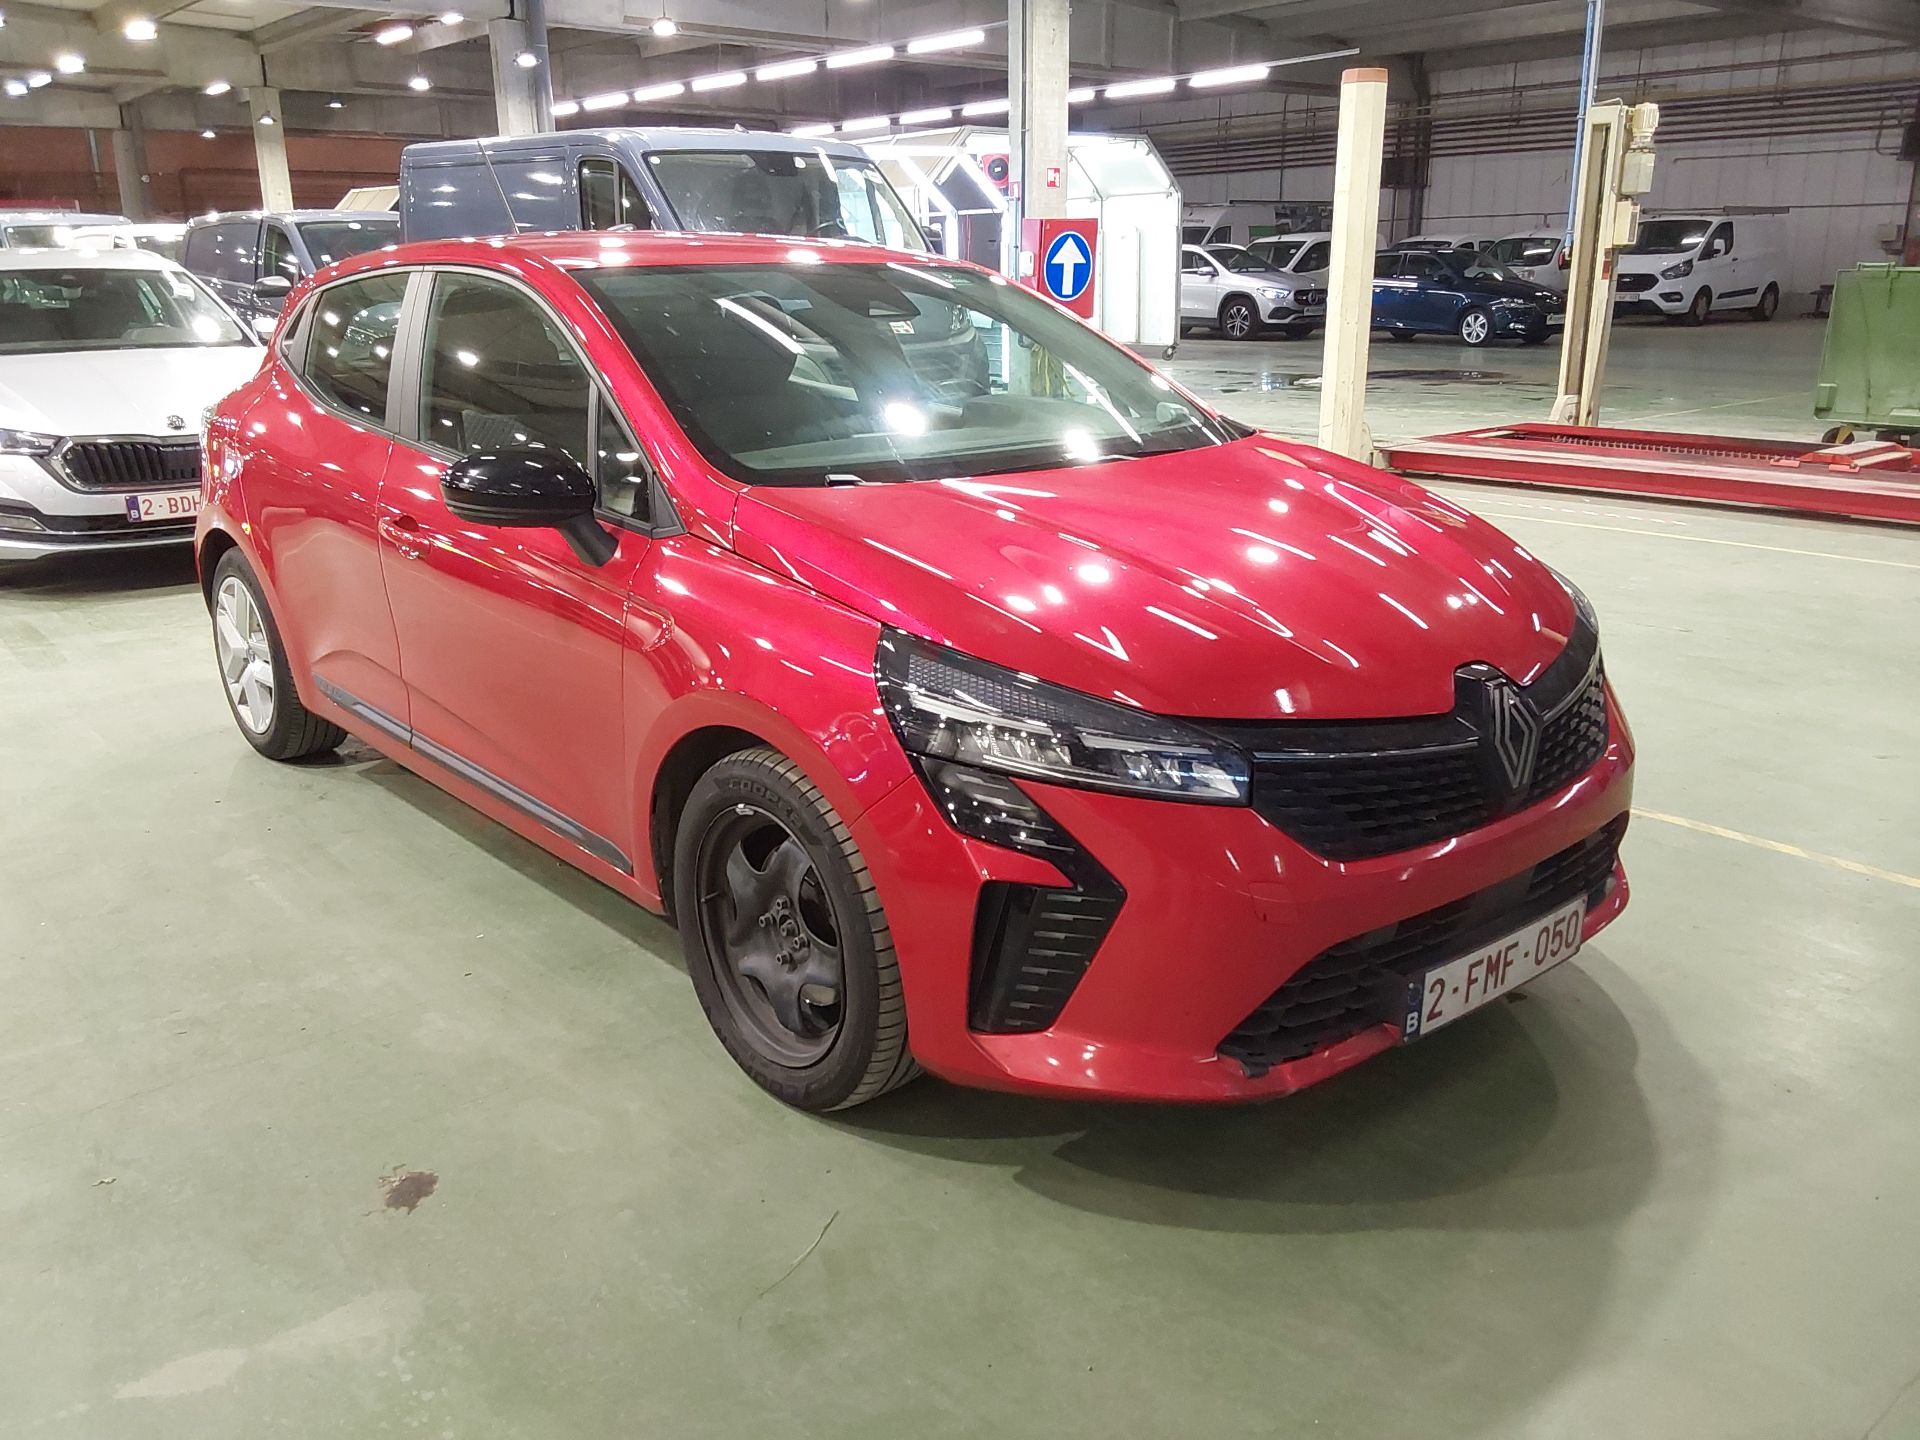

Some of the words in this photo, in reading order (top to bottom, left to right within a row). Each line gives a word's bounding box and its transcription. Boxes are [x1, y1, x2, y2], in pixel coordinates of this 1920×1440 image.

[130, 510, 139, 518] B
[1426, 910, 1580, 1022] 2-FMF-050
[1406, 1011, 1418, 1034] B
